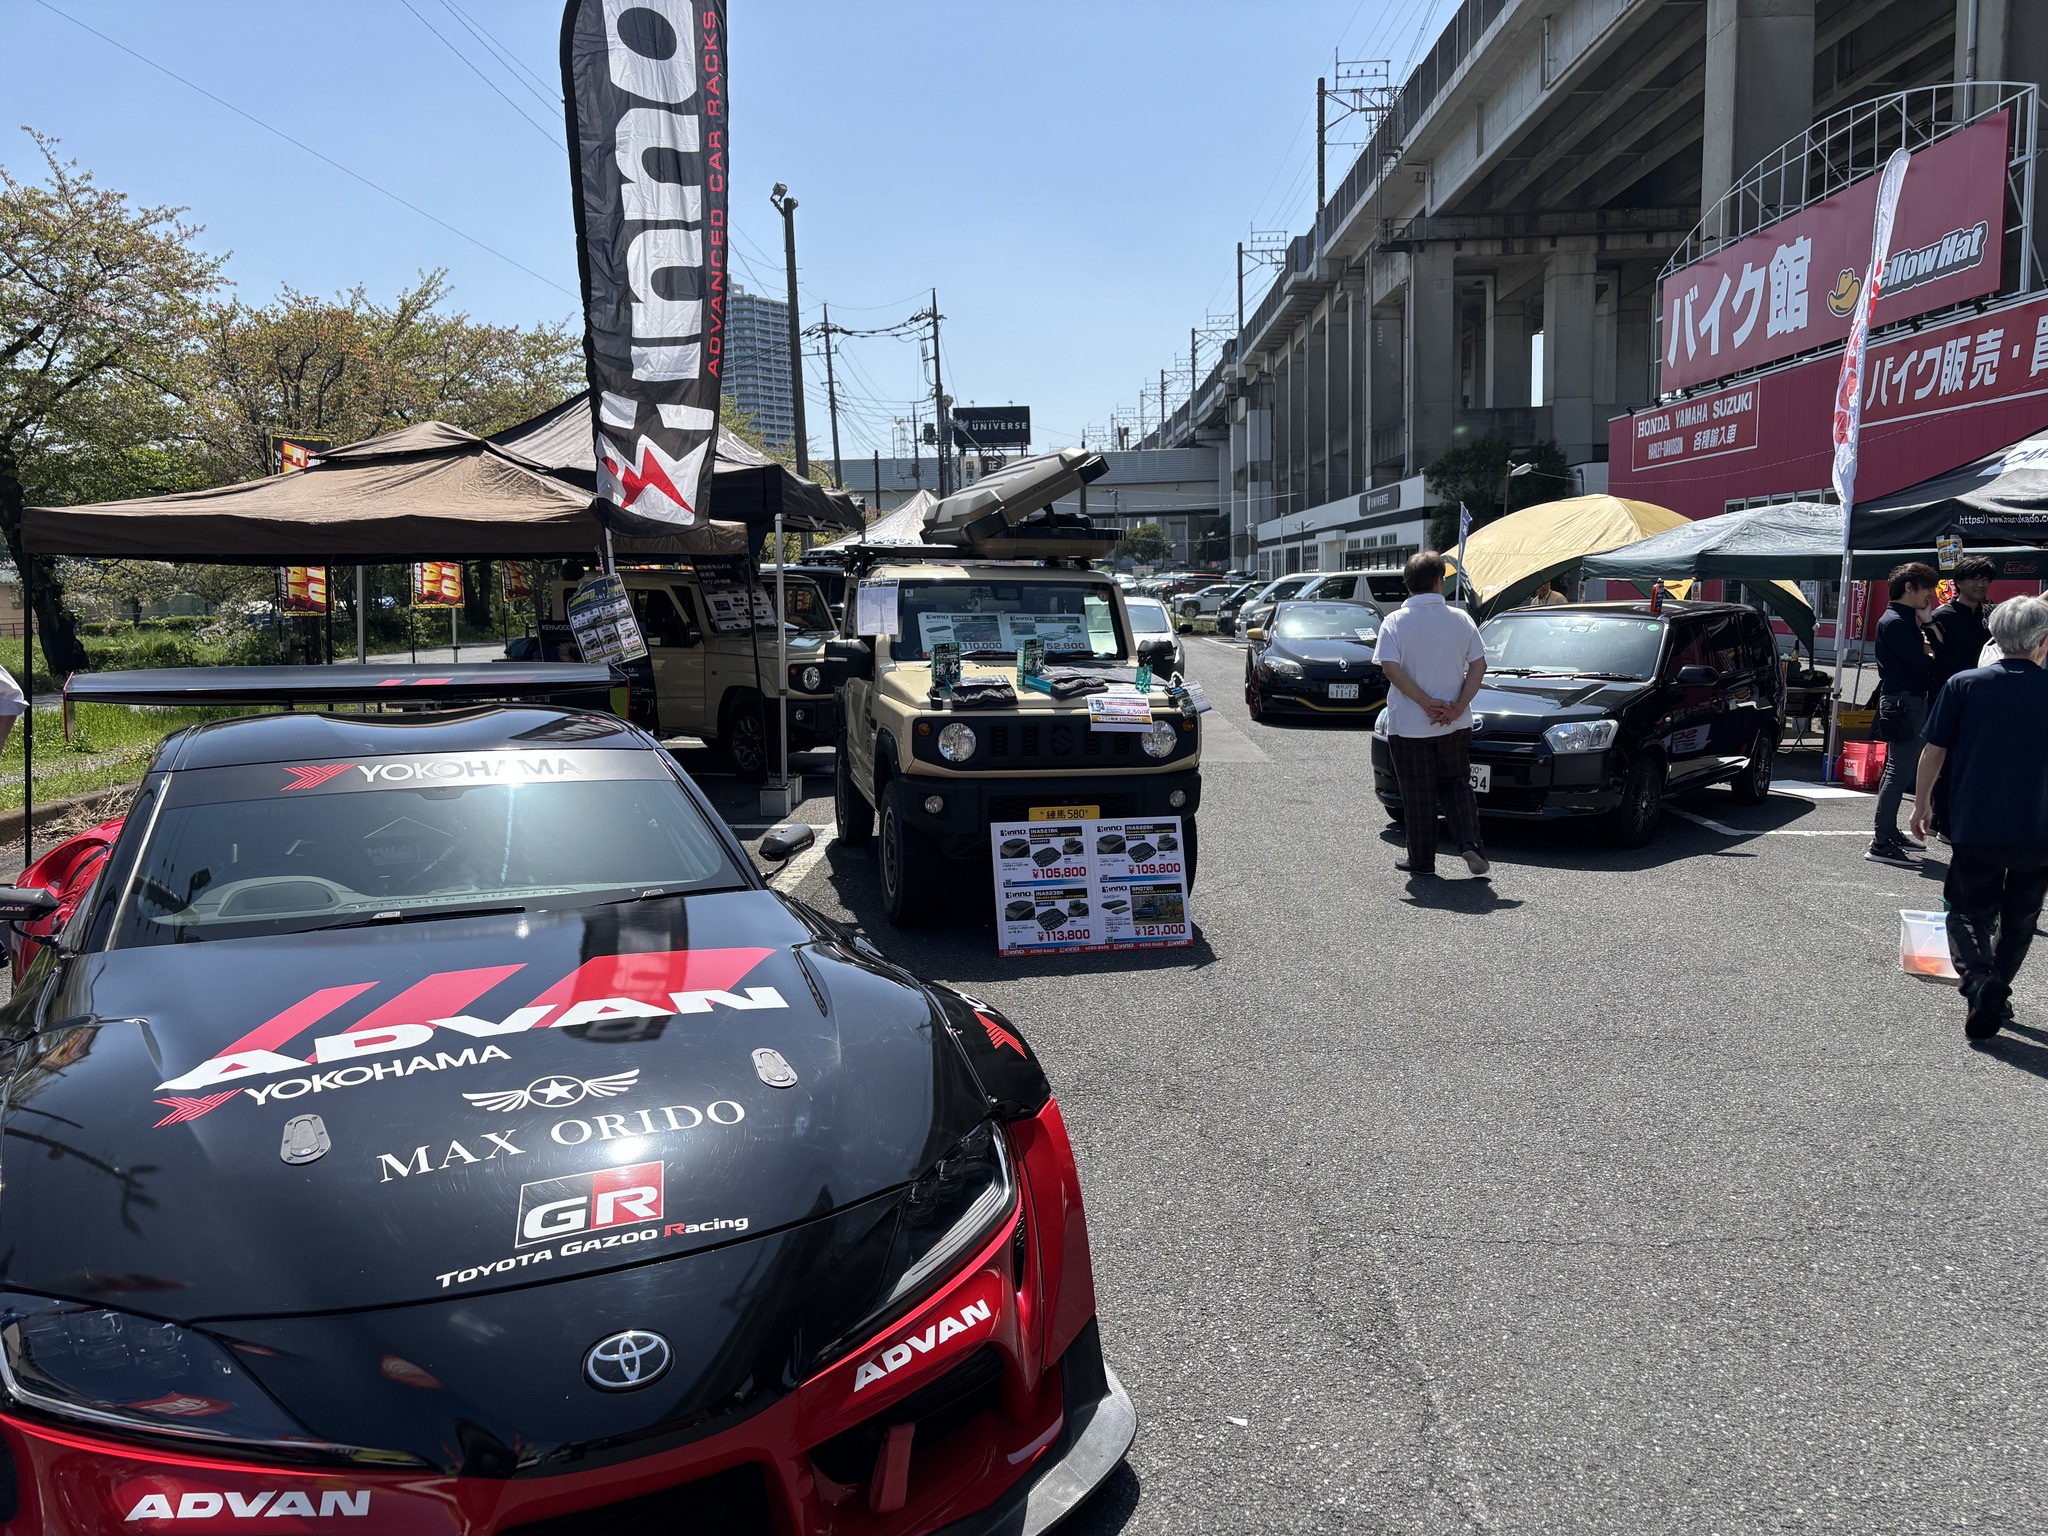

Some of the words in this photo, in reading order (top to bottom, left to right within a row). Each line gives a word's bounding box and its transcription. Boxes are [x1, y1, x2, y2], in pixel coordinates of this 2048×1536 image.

[703, 11, 721, 116] RACKS
[708, 130, 724, 192] CAR
[1880, 227, 1984, 289] ellowHat
[705, 209, 726, 377] ADVANCED
[1667, 235, 1812, 369] バイク館
[972, 422, 1027, 431] UNIVERSE
[1638, 415, 1671, 438] HONDA
[1675, 403, 1708, 429] YAMAHA
[1713, 391, 1753, 420] SUZUKI
[1693, 424, 1738, 451] 各種輸入車
[1648, 437, 1684, 460] HARLEY-DAVIDSON
[357, 755, 580, 784] YOKOHAMA
[1046, 810, 1066, 819] 練馬
[1068, 809, 1085, 819] 580
[1033, 867, 1087, 879] ¥105,800
[1129, 863, 1181, 875] ¥109,800
[1038, 929, 1091, 942] ¥113,800
[1135, 924, 1186, 936] ¥121,000
[154, 986, 790, 1091] ADVAN
[244, 1045, 512, 1106] YOKOHAMA
[378, 1129, 526, 1183] MAX
[550, 1101, 746, 1147] ORIDO
[522, 1185, 659, 1241] GR
[435, 1249, 553, 1288] TOYOTA
[560, 1229, 658, 1257] GAZOO
[664, 1214, 749, 1237] Racing
[853, 1298, 992, 1393] ADVAN
[124, 1490, 371, 1521] ADVAN
